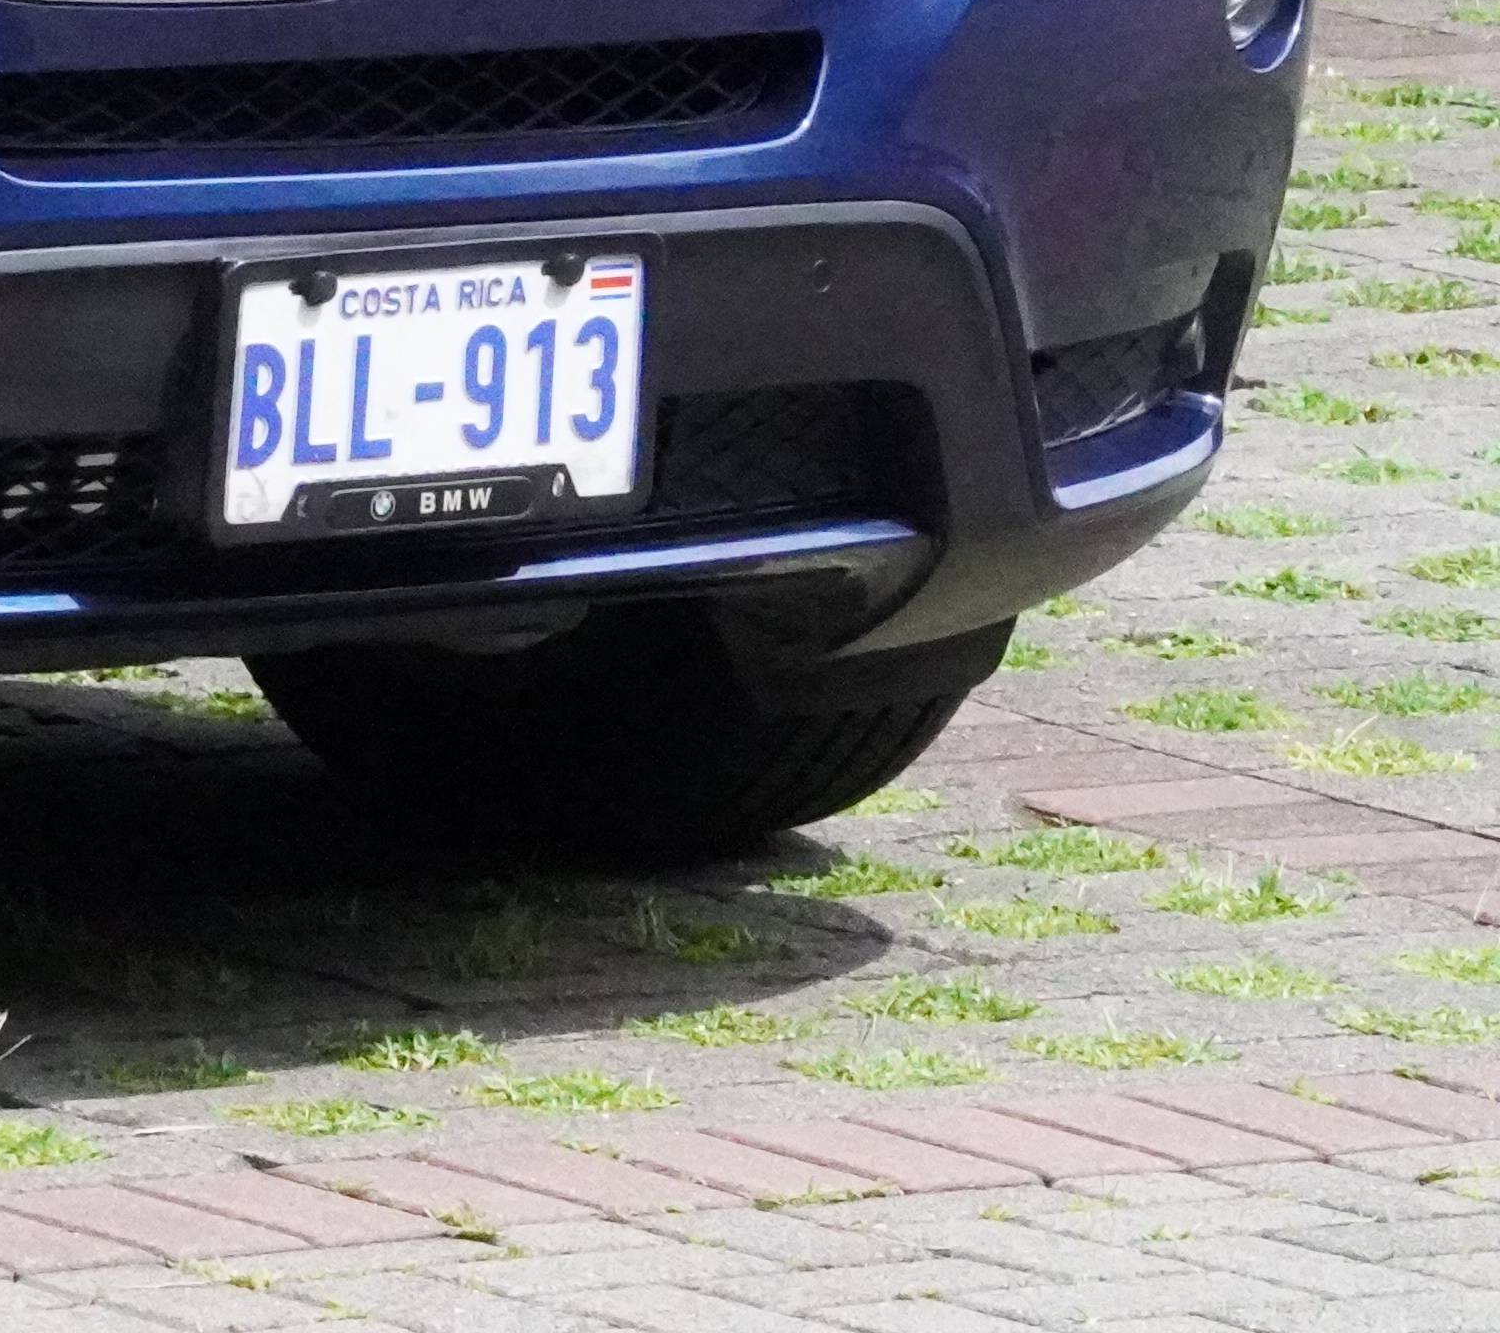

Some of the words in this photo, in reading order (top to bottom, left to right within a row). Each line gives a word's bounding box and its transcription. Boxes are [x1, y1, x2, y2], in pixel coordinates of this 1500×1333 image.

[339, 282, 442, 320] COSTA
[456, 275, 528, 311] RICA
[235, 314, 621, 471] BLL-913
[418, 486, 494, 516] BMW
